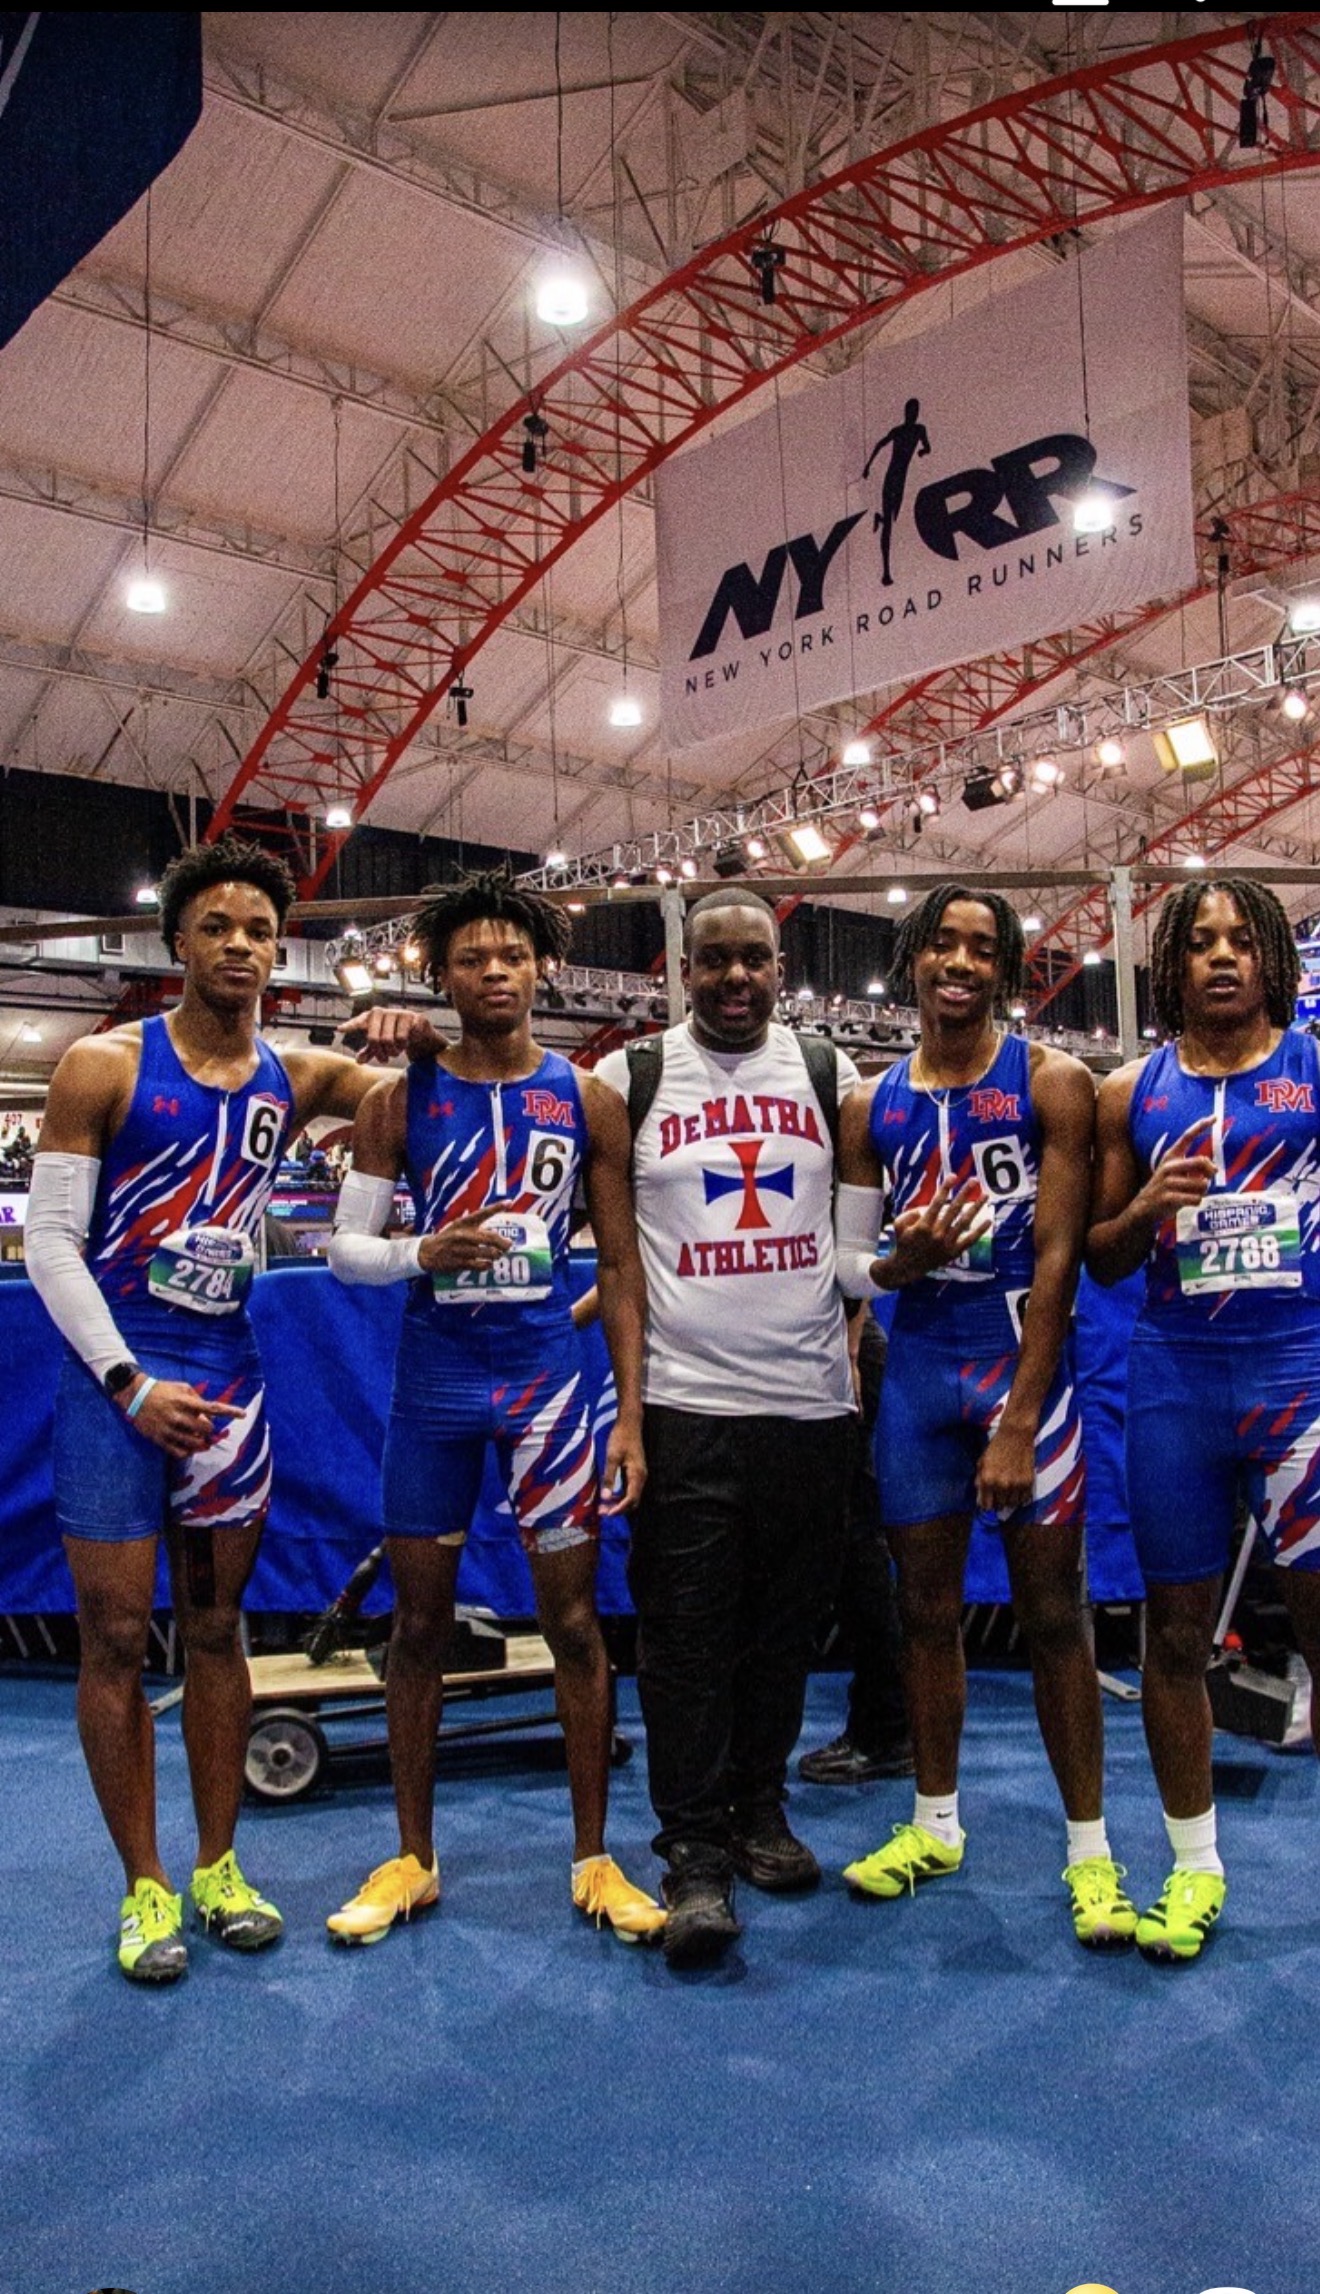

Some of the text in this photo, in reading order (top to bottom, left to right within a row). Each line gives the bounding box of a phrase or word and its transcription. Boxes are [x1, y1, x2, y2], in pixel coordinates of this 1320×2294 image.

[685, 514, 1143, 694] NEW YORK ROAD RUNNERS
[249, 1106, 278, 1160] 6
[532, 1138, 566, 1192] 6
[982, 1143, 1020, 1195] 6
[168, 1259, 234, 1299] 2784
[677, 1232, 818, 1277] ATHLETICS
[1200, 1235, 1280, 1274] 2788
